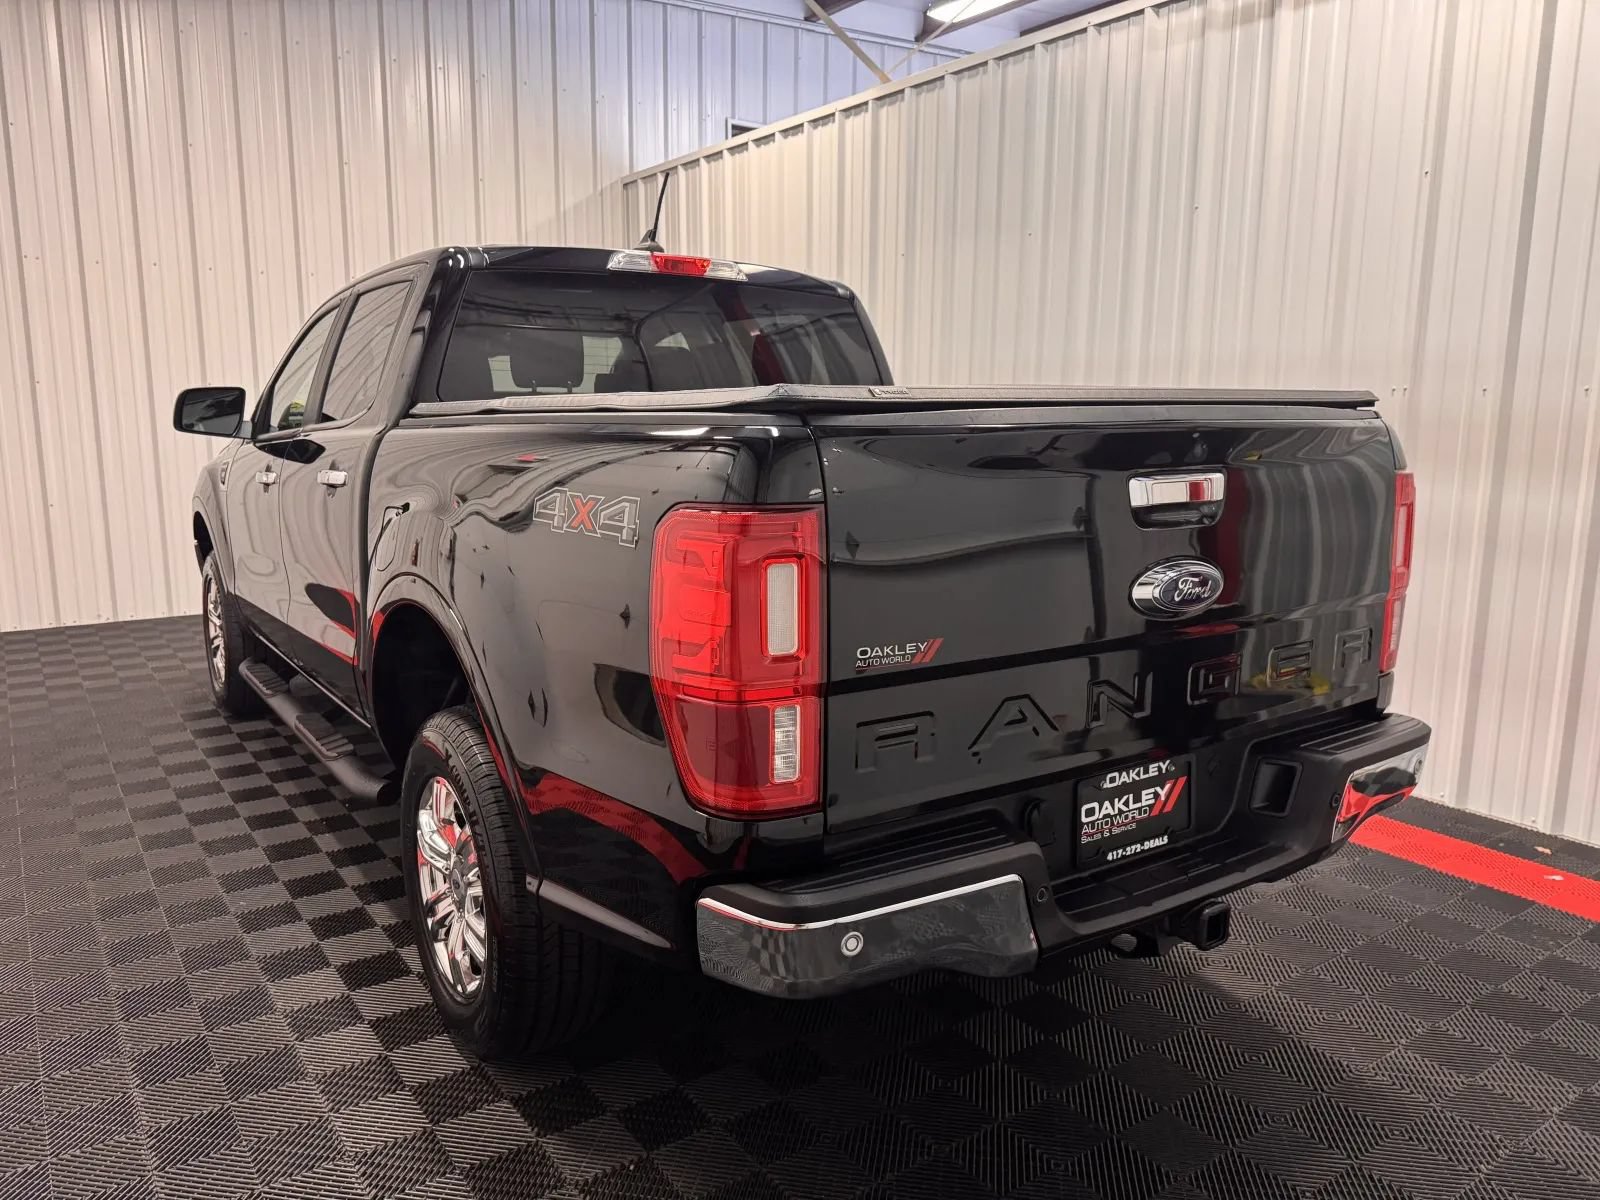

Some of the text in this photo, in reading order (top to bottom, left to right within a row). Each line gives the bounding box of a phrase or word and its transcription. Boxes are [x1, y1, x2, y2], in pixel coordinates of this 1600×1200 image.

[532, 487, 640, 548] 4X4
[1174, 577, 1211, 601] Ford
[855, 654, 911, 667] AUTO WORLD
[856, 641, 928, 659] OAKLEY
[855, 627, 1373, 774] RANGER
[1105, 759, 1171, 788] OAKLEY
[1081, 783, 1172, 823] OAKLEY
[1081, 806, 1149, 835] AUTO WORLD
[1103, 830, 1110, 838] &
[1106, 835, 1169, 861] 417-272-DEALS
